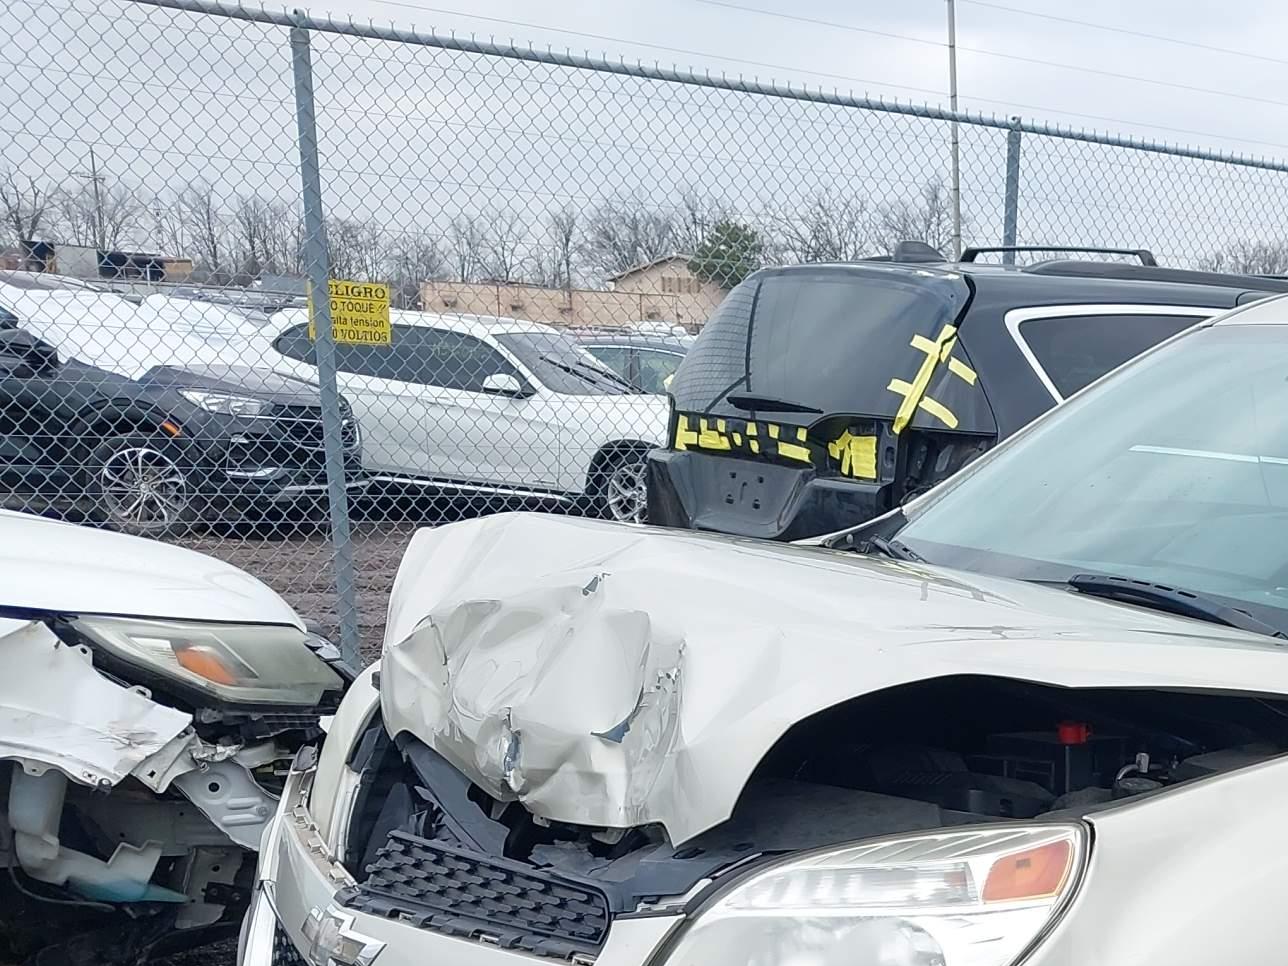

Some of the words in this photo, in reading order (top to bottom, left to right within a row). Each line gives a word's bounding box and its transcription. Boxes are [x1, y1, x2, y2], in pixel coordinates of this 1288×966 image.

[328, 284, 386, 298] ELIGRO
[340, 302, 375, 313] TOQUE
[340, 329, 388, 342] VOLTIOS
